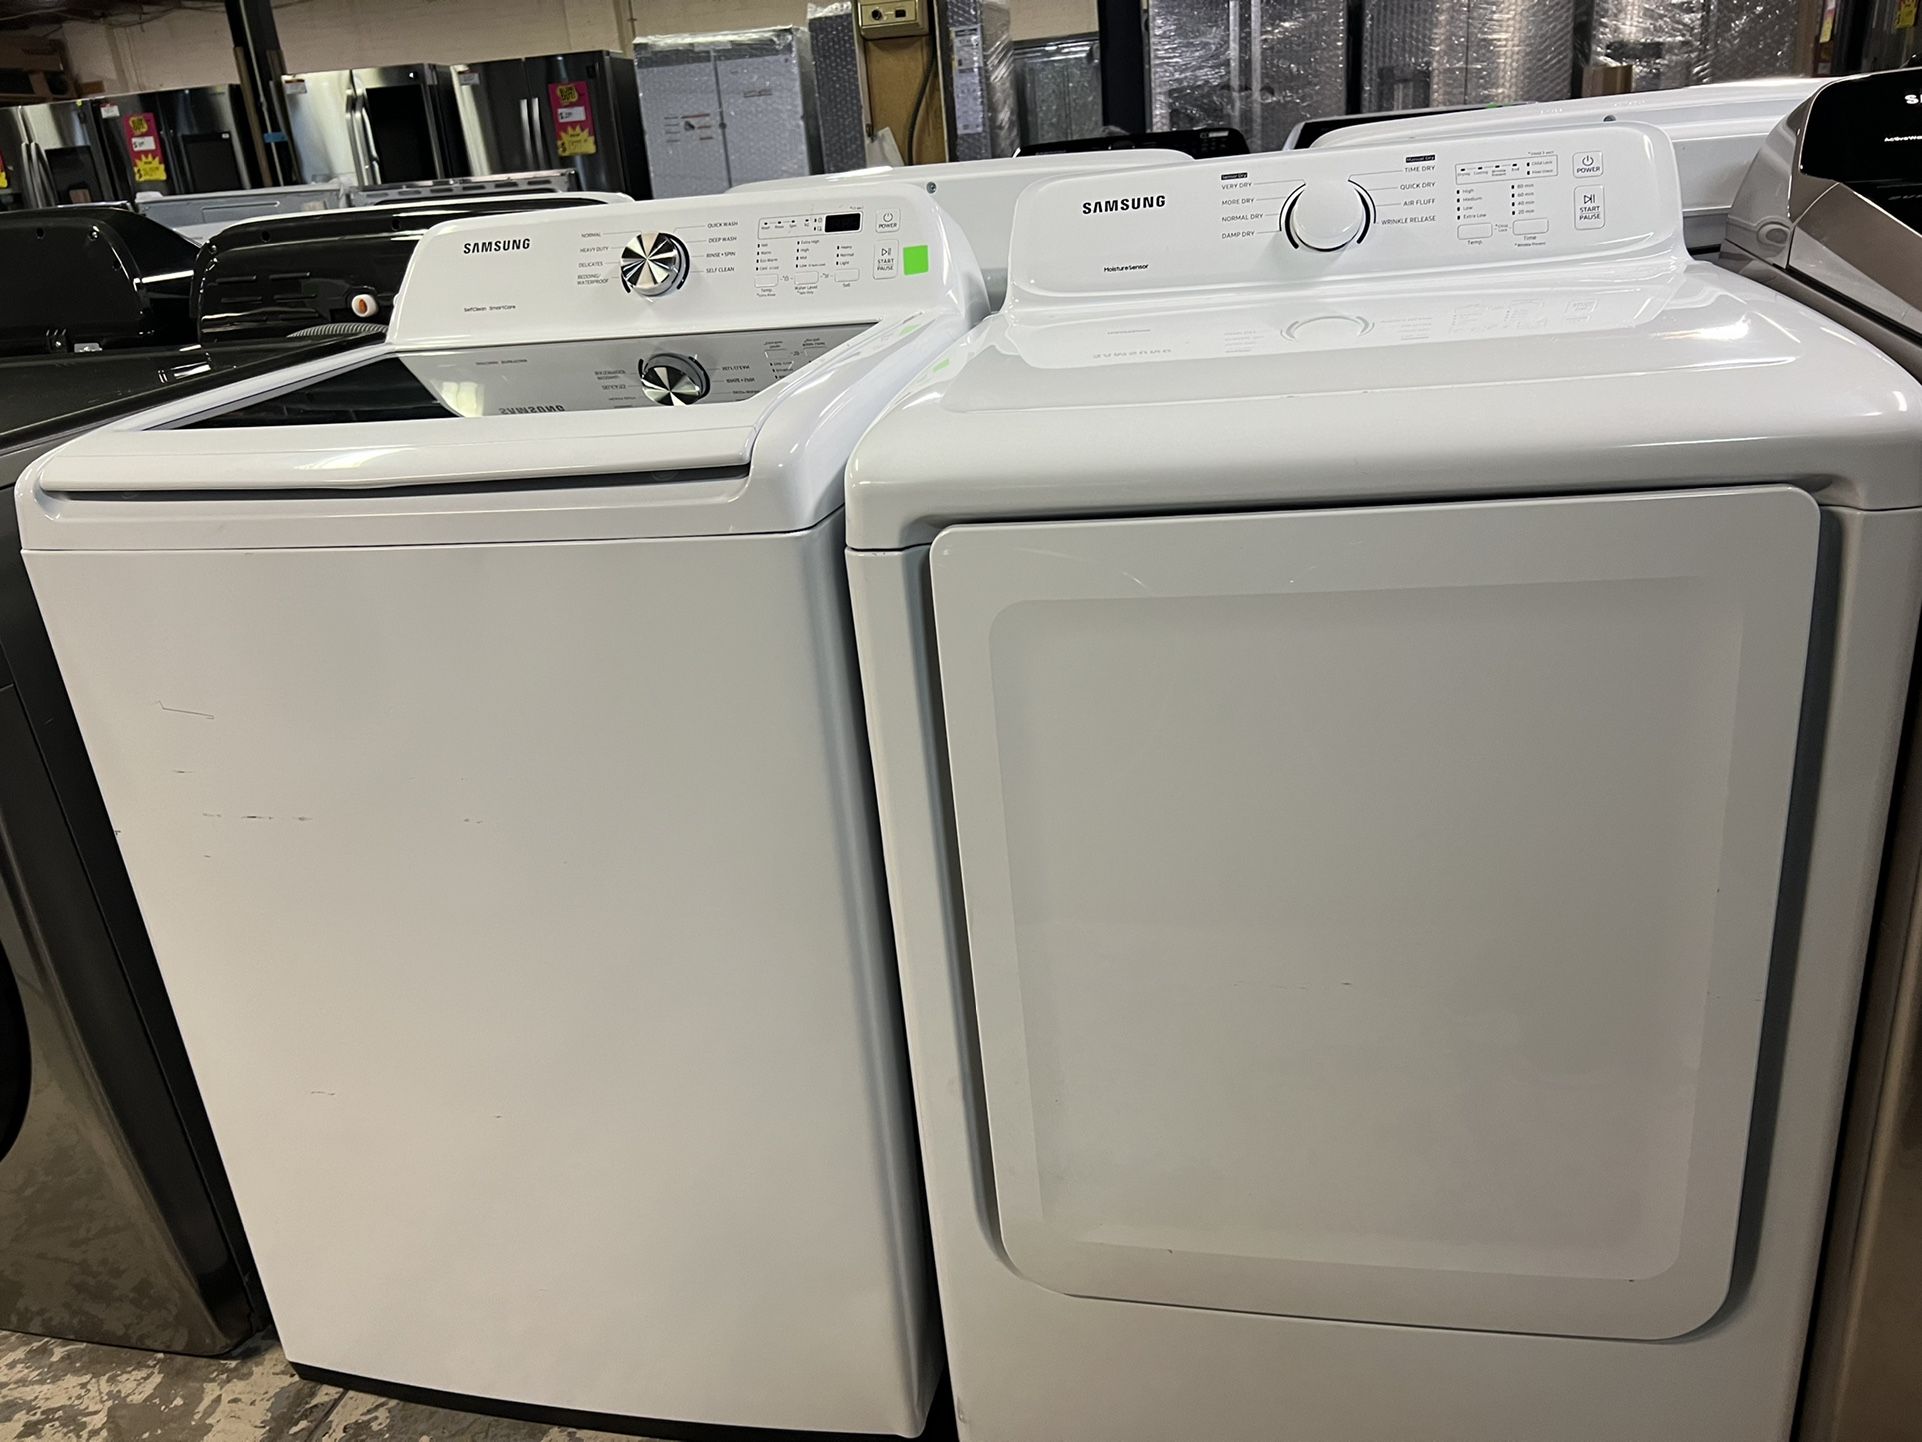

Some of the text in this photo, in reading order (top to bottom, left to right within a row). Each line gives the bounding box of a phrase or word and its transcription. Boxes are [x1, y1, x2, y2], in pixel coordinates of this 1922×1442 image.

[1082, 194, 1166, 214] SAMSUNG
[1579, 205, 1601, 213] START
[1381, 215, 1436, 225] WRINKLE RELEASE
[1579, 213, 1601, 221] PAUSE
[1221, 230, 1255, 239] DAMP DRY
[463, 238, 531, 254] SAMSUNG
